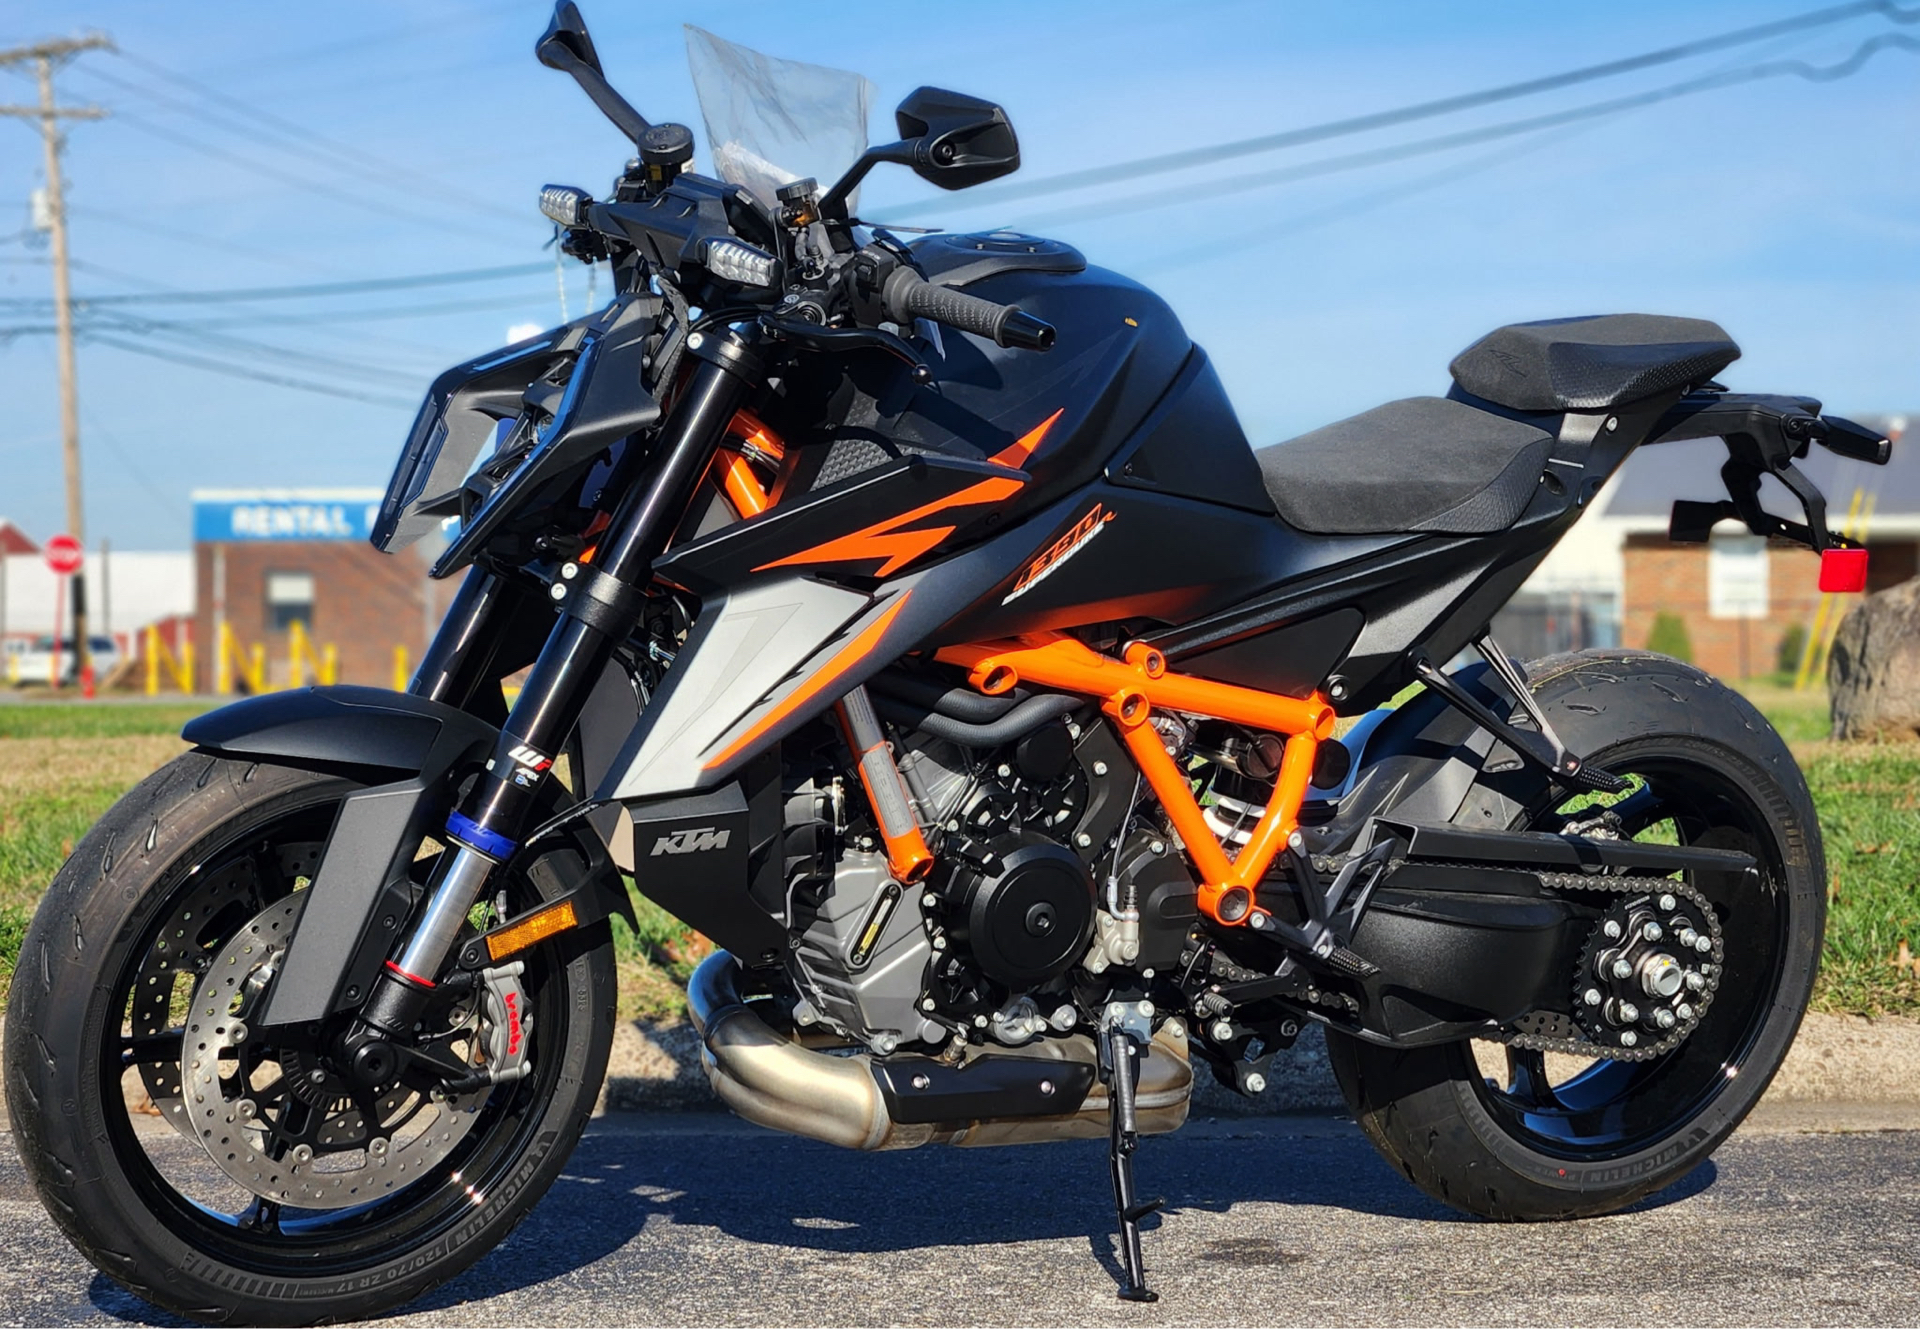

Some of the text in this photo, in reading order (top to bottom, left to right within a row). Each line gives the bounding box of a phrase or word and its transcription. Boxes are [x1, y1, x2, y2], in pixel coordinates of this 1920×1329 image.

[231, 504, 352, 536] RENTAL
[1013, 502, 1103, 592] 1390
[507, 745, 554, 771] WP
[650, 827, 732, 857] KTM
[504, 992, 524, 1056] brembo
[1590, 1146, 1679, 1183] MICHELIN
[454, 1160, 535, 1247] MICHELIN
[387, 1246, 443, 1280] 120/70
[336, 1278, 355, 1294] 17
[360, 1273, 382, 1289] ZR
